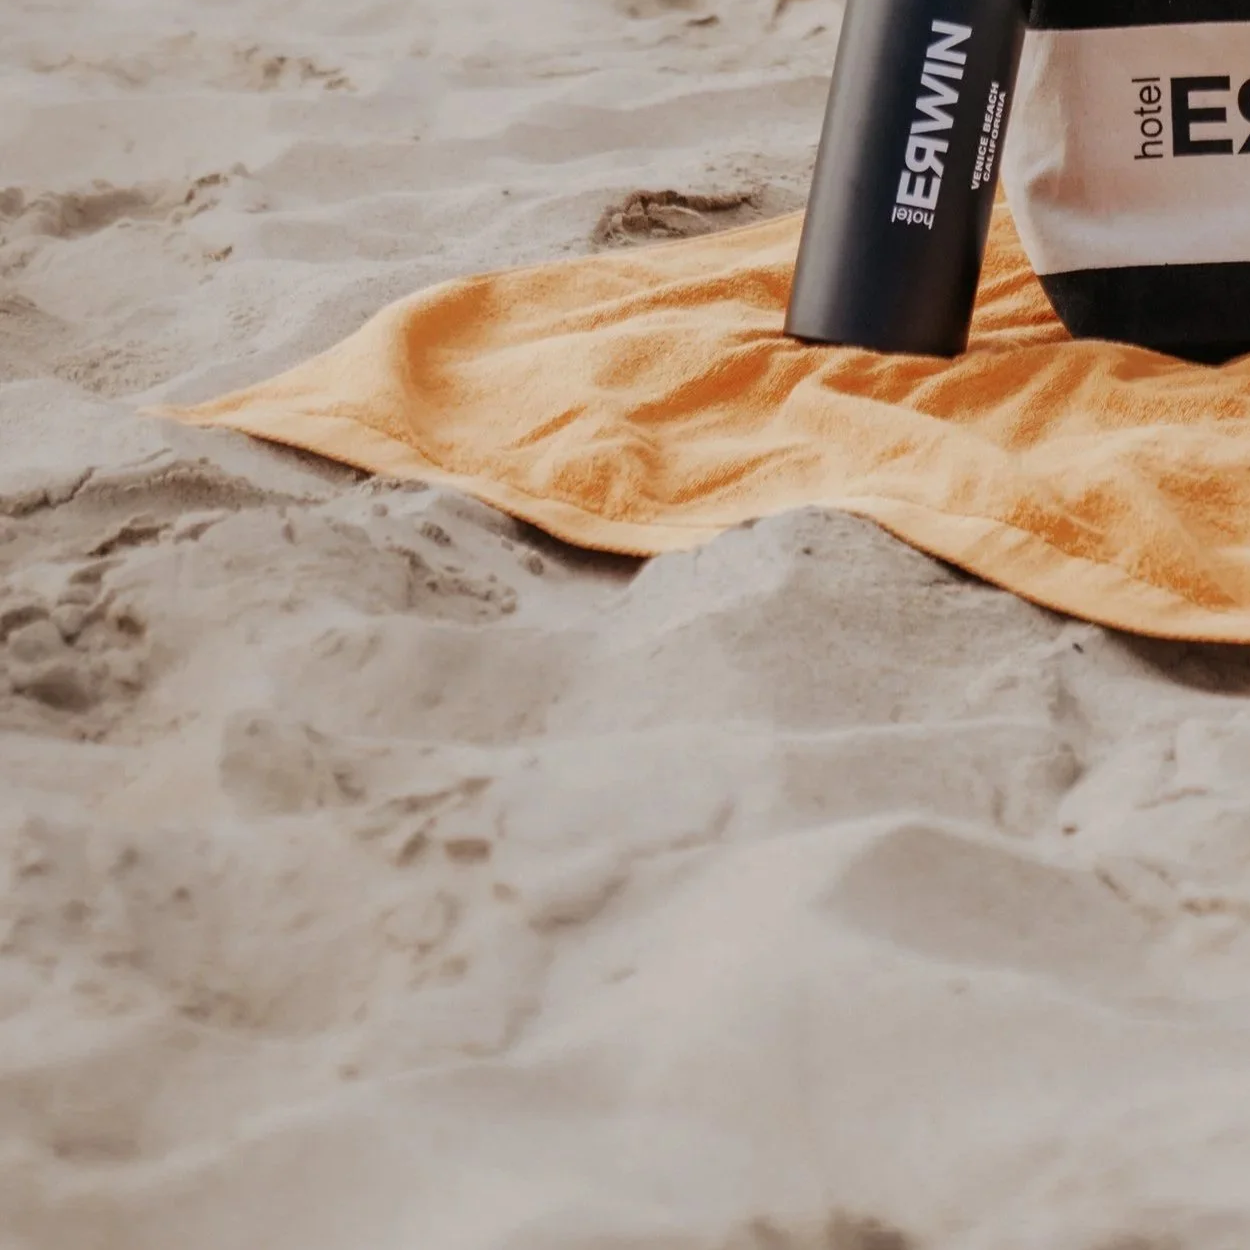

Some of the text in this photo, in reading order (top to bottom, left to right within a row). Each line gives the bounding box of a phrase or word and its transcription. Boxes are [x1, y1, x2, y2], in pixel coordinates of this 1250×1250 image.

[895, 19, 973, 211] ERWIN
[970, 81, 1000, 190] VENICE BEACH
[982, 91, 1007, 182] CALIFORNIA
[1131, 76, 1164, 161] hotel
[891, 205, 935, 230] hotel
